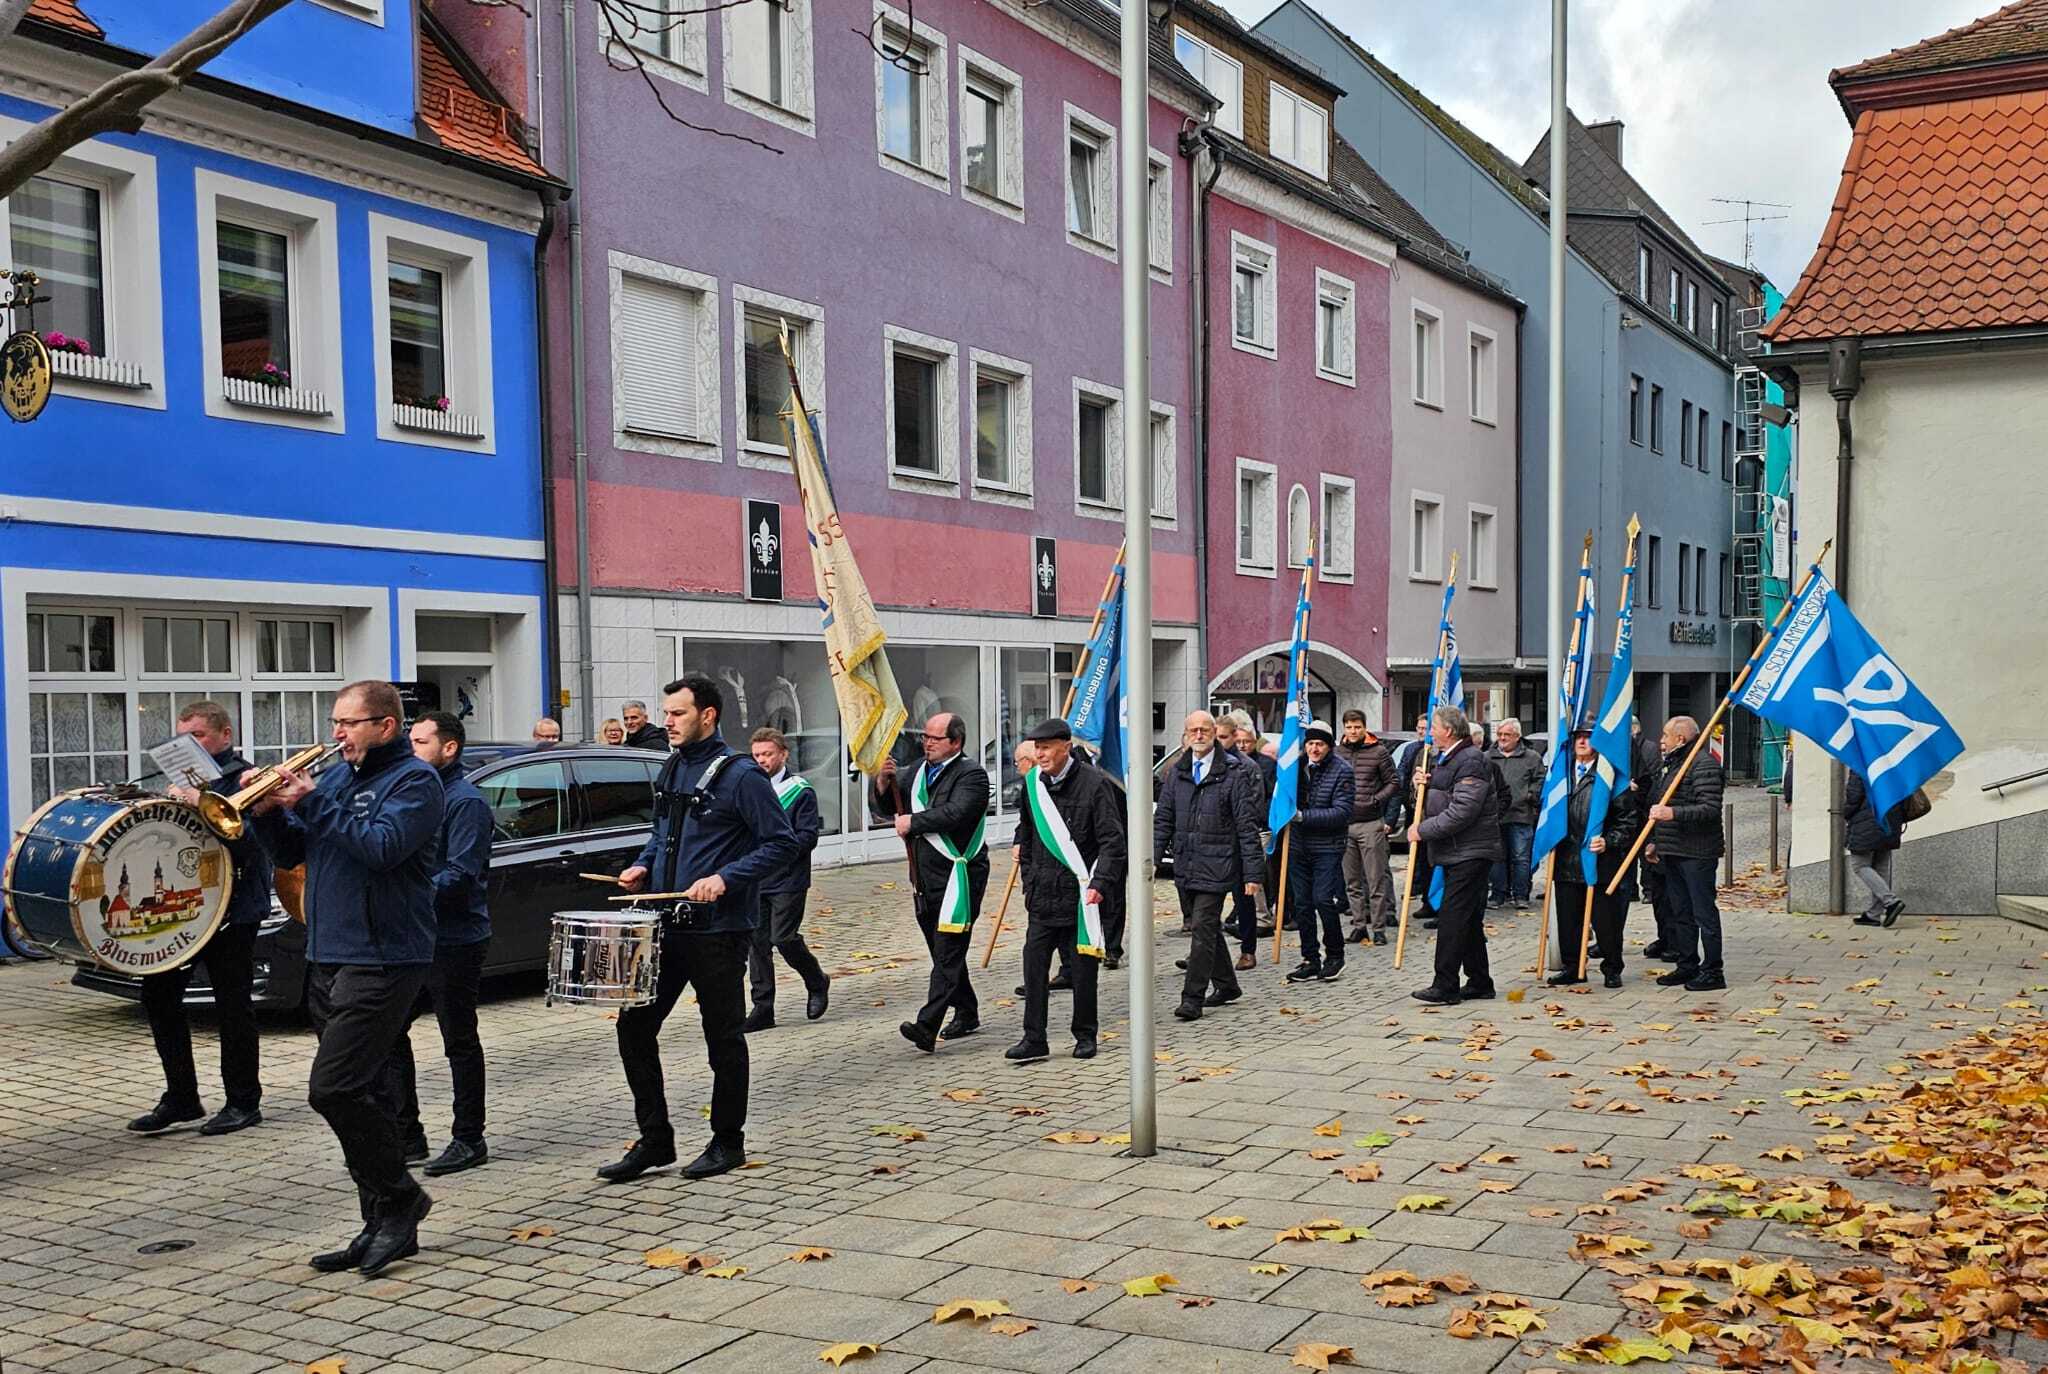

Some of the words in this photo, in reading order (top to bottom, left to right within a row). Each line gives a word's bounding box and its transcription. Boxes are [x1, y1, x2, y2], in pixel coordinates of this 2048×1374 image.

[1074, 656, 1109, 729] REGENSBURG
[1745, 680, 1771, 707] MMC
[97, 930, 197, 967] Blasmusik
